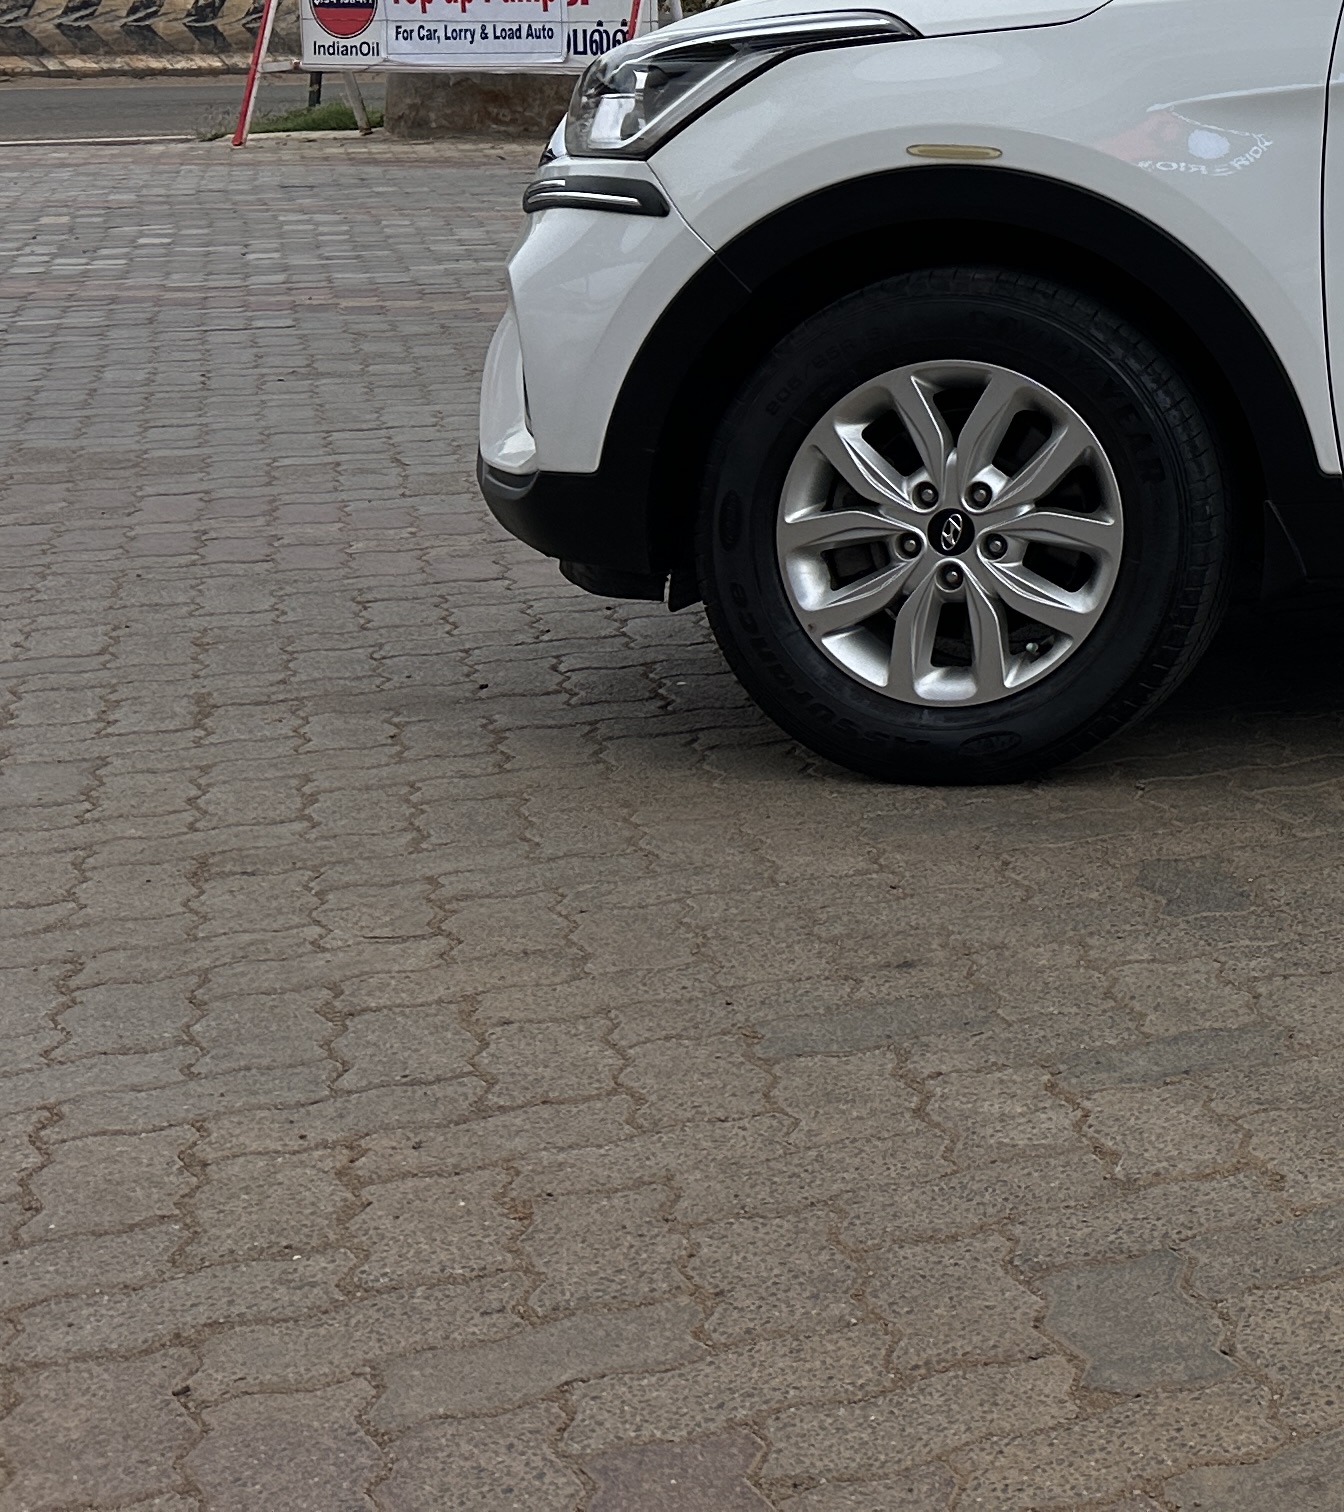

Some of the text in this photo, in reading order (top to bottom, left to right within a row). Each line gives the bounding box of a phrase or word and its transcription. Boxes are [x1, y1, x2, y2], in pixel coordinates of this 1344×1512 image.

[395, 25, 415, 42] For
[417, 23, 441, 45] Car,
[443, 23, 476, 45] Lorry
[479, 23, 489, 41] &
[492, 23, 522, 40] Load
[525, 23, 554, 40] Auto
[313, 40, 380, 57] IndianOil
